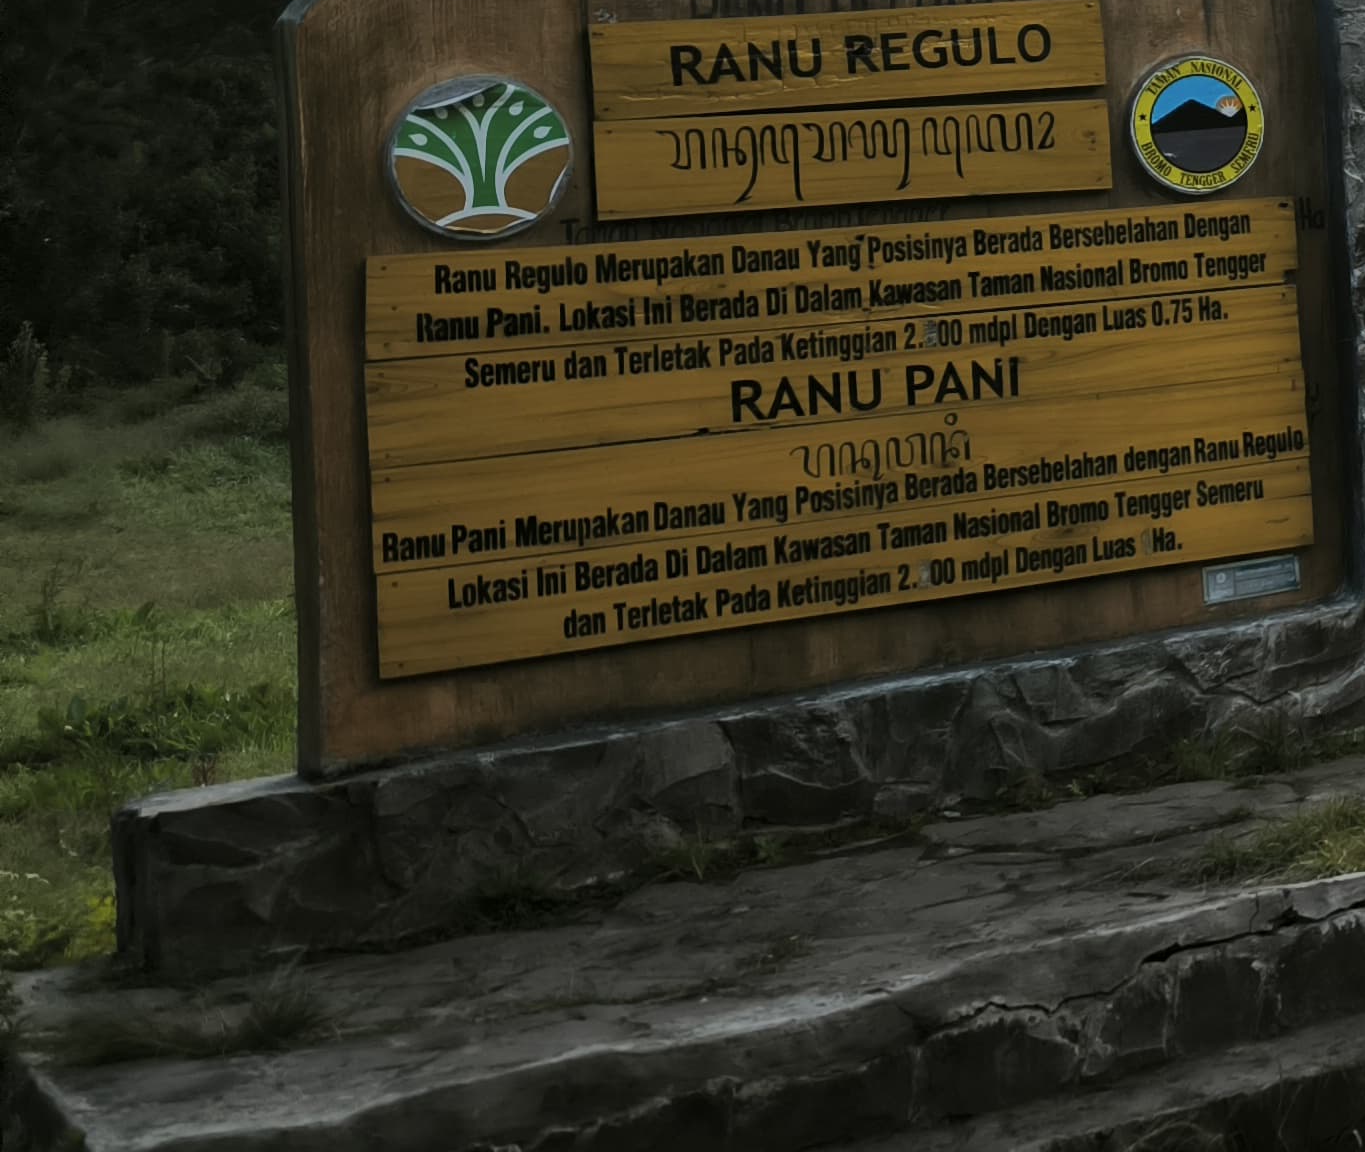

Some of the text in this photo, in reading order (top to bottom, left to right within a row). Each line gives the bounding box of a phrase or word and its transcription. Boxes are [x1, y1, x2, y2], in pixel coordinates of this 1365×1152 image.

[670, 23, 1052, 87] RANU REGULO
[1146, 60, 1243, 96] TAMAN NASIONAL
[1140, 132, 1260, 186] BROMO TENGGER SEMERU
[434, 213, 1251, 295] Ranu Regulo Merupakan Danau Yang Posisinya Berada Bersebelahan Dengan
[416, 252, 1267, 344] Ranu Pani. Lokasi Ini Berada Di Dalam Kawasan Taman Nasional Bromo Tengger
[464, 295, 1229, 389] Semeru dan Terletak Pada Ketinggian 2.00 mdpl Dengan Luas 0.75 Ha.
[730, 356, 1022, 423] RANU PANI
[451, 519, 507, 555] Pani
[514, 507, 649, 548] Merupakan
[653, 501, 726, 532] Danau
[732, 491, 789, 524] Yang
[795, 480, 899, 516] Posisinya
[904, 467, 978, 501] Berada
[983, 451, 1118, 491] Bersebelahan
[1123, 445, 1192, 474] dengan
[1193, 437, 1240, 464] Ranu
[1242, 426, 1304, 460] Regulo
[447, 479, 1265, 610] Lokasi Ini Berada Di Dalam Kawasan Taman Nasional Bromo Tengger Semeru
[563, 608, 606, 639] dan
[613, 591, 708, 631] Terletak
[715, 584, 771, 617] Pada
[777, 569, 891, 609] Ketinggian
[897, 557, 956, 591] 2.00
[961, 546, 1010, 585] mdpl
[1015, 543, 1087, 573] Dengan
[1092, 536, 1137, 562] Luas
[1152, 527, 1183, 553] Ha.
